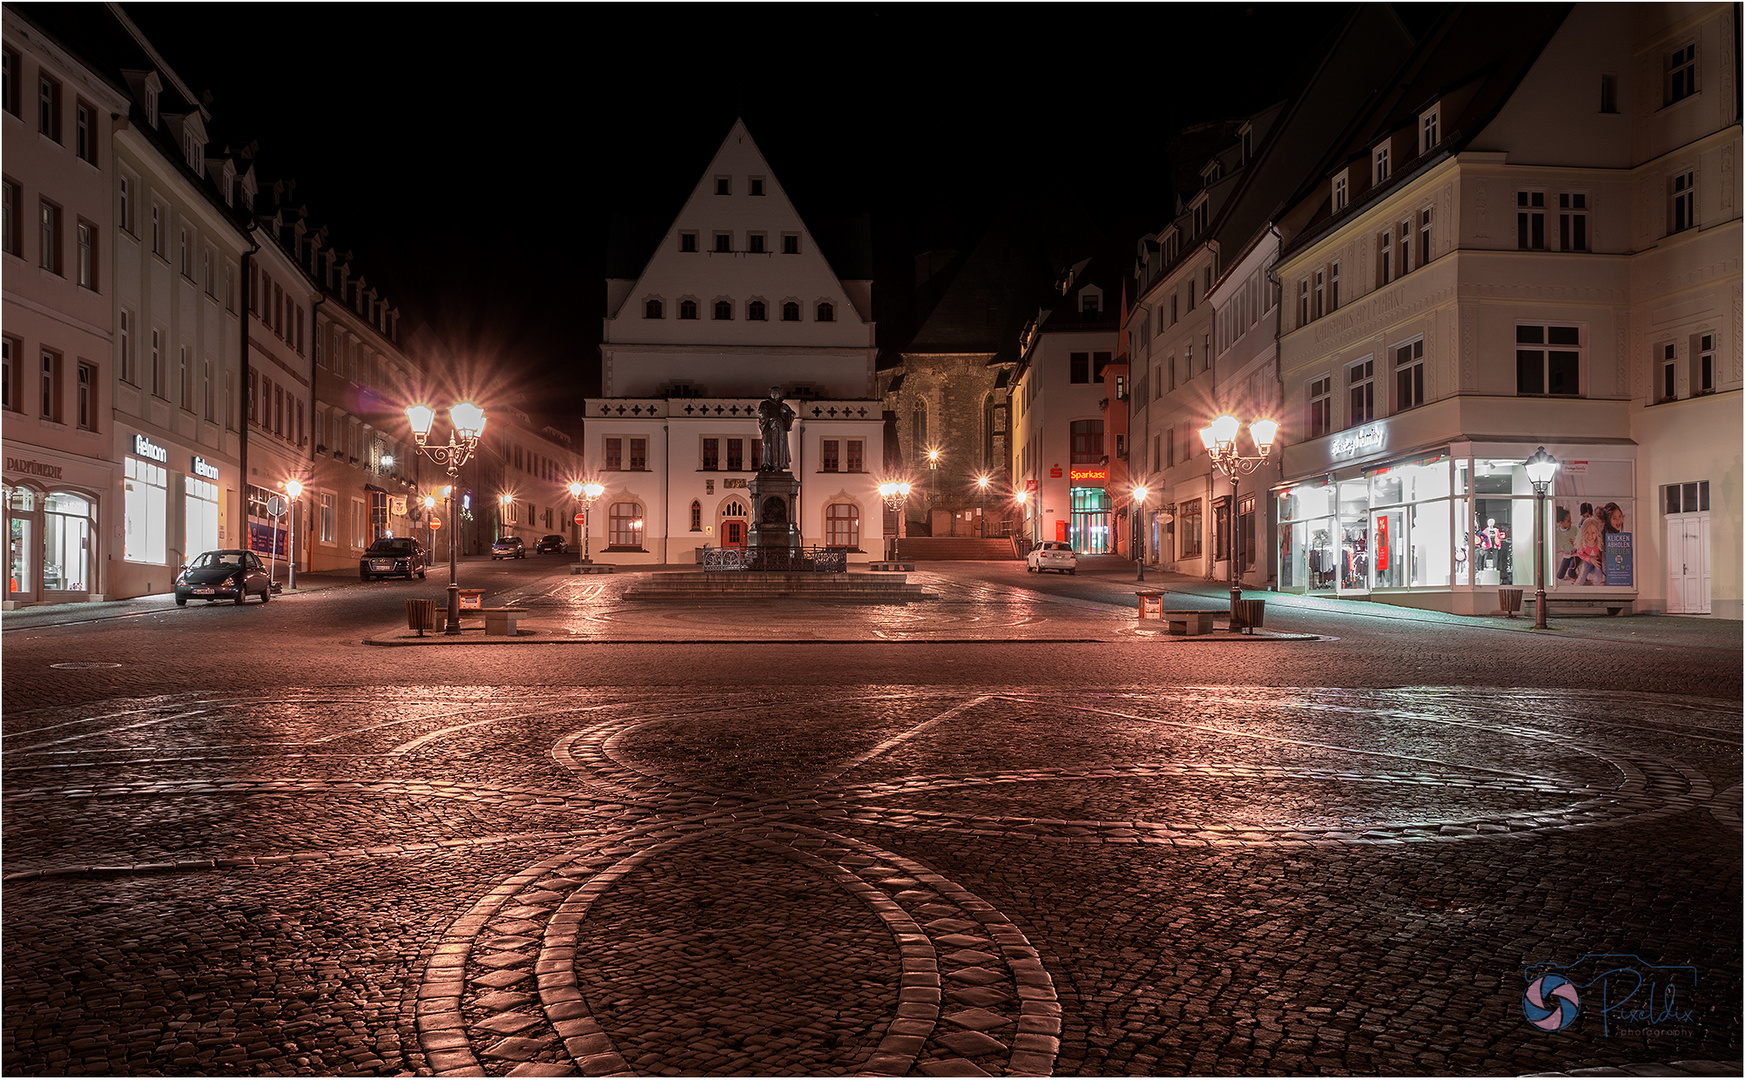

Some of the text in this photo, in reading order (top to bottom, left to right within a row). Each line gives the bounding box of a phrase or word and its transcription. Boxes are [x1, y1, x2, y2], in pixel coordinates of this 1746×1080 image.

[6, 457, 62, 480] PARFÜMERIE
[1607, 534, 1630, 542] KLICKEN
[1607, 547, 1631, 555] FREUEN
